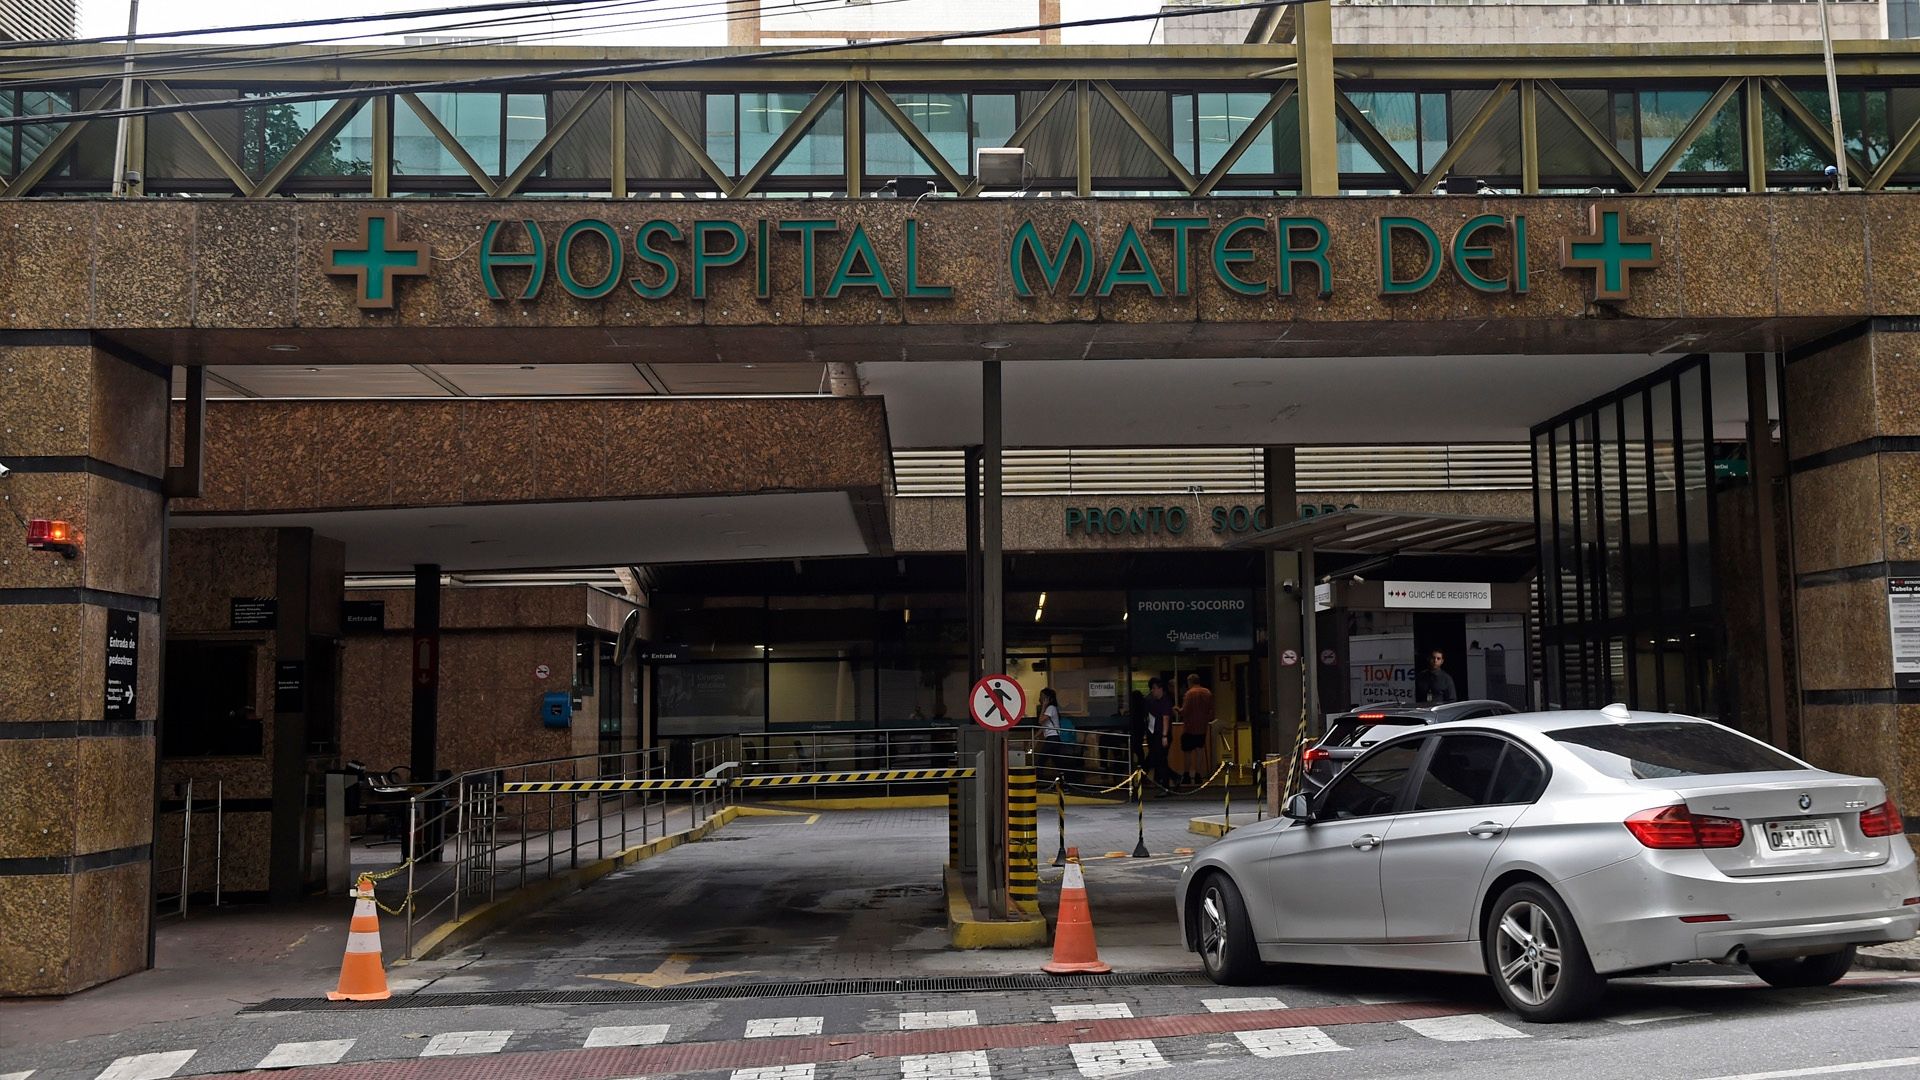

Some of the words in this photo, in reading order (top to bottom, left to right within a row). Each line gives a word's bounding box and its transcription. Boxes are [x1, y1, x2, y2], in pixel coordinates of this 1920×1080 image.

[479, 216, 955, 299] HOSPITAL
[1008, 215, 1335, 298] MATER
[1376, 213, 1531, 295] DEI
[1066, 506, 1187, 535] PRONTO
[1436, 591, 1446, 599] DE
[1448, 591, 1488, 600] REGISTROS
[109, 635, 128, 649] Entrada
[128, 637, 136, 650] de
[1179, 631, 1219, 641] MaterDei
[108, 653, 133, 667] pedestres
